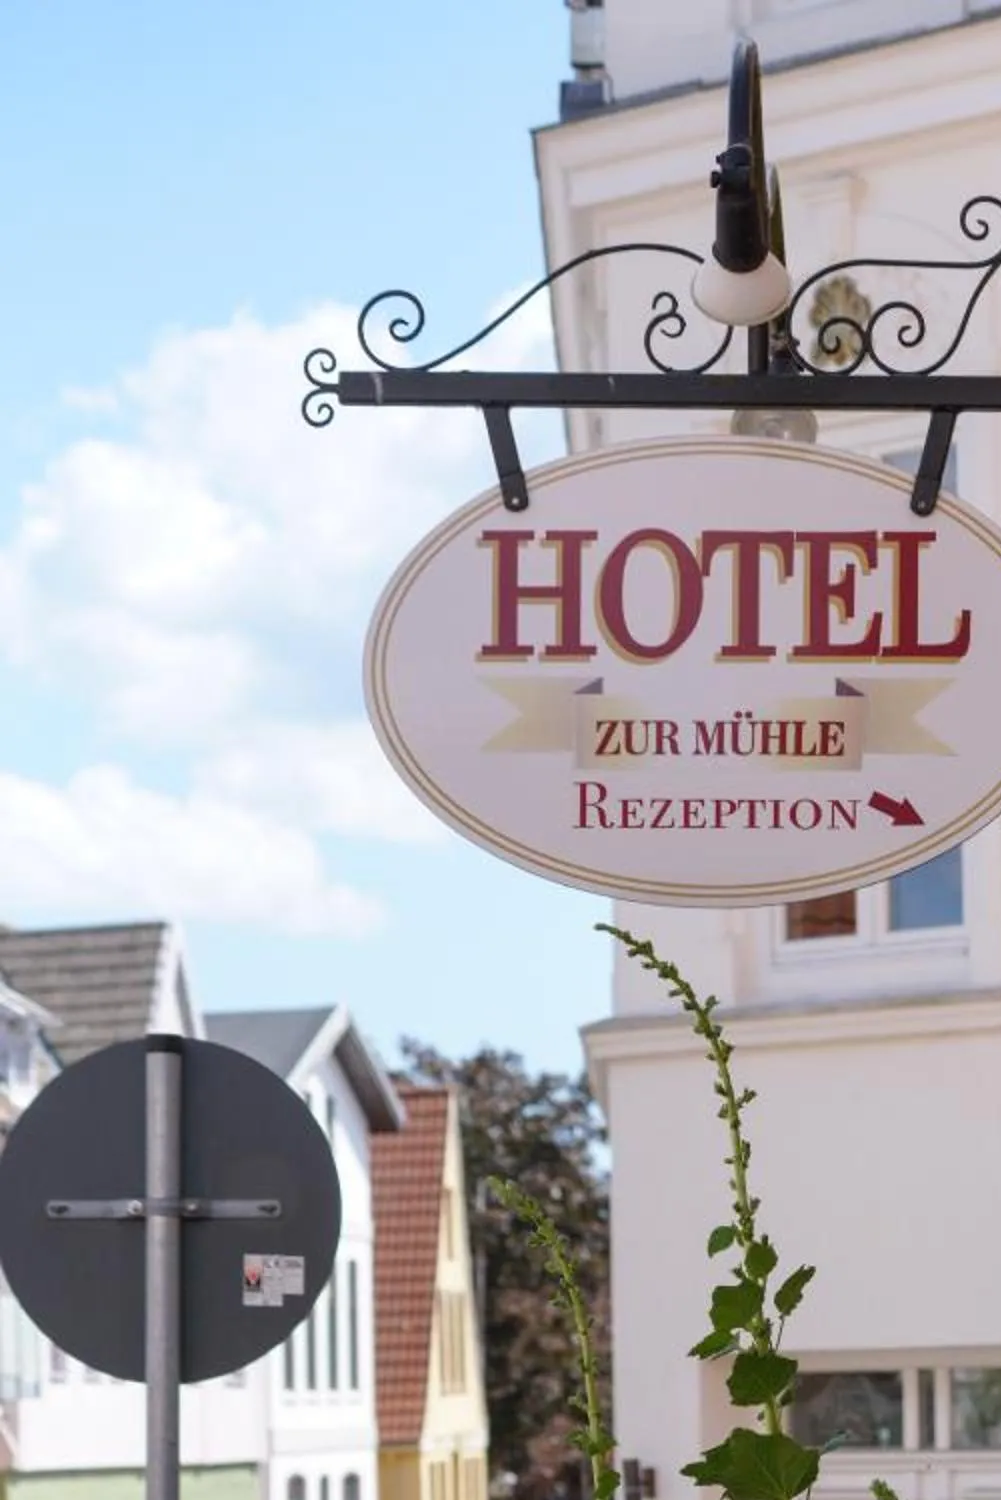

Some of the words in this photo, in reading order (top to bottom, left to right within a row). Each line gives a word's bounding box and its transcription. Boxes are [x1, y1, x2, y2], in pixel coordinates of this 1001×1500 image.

[477, 528, 972, 663] HOTEL
[595, 719, 681, 757] ZUR
[693, 711, 846, 758] MÜHLE
[573, 781, 859, 831] REZEPTION
